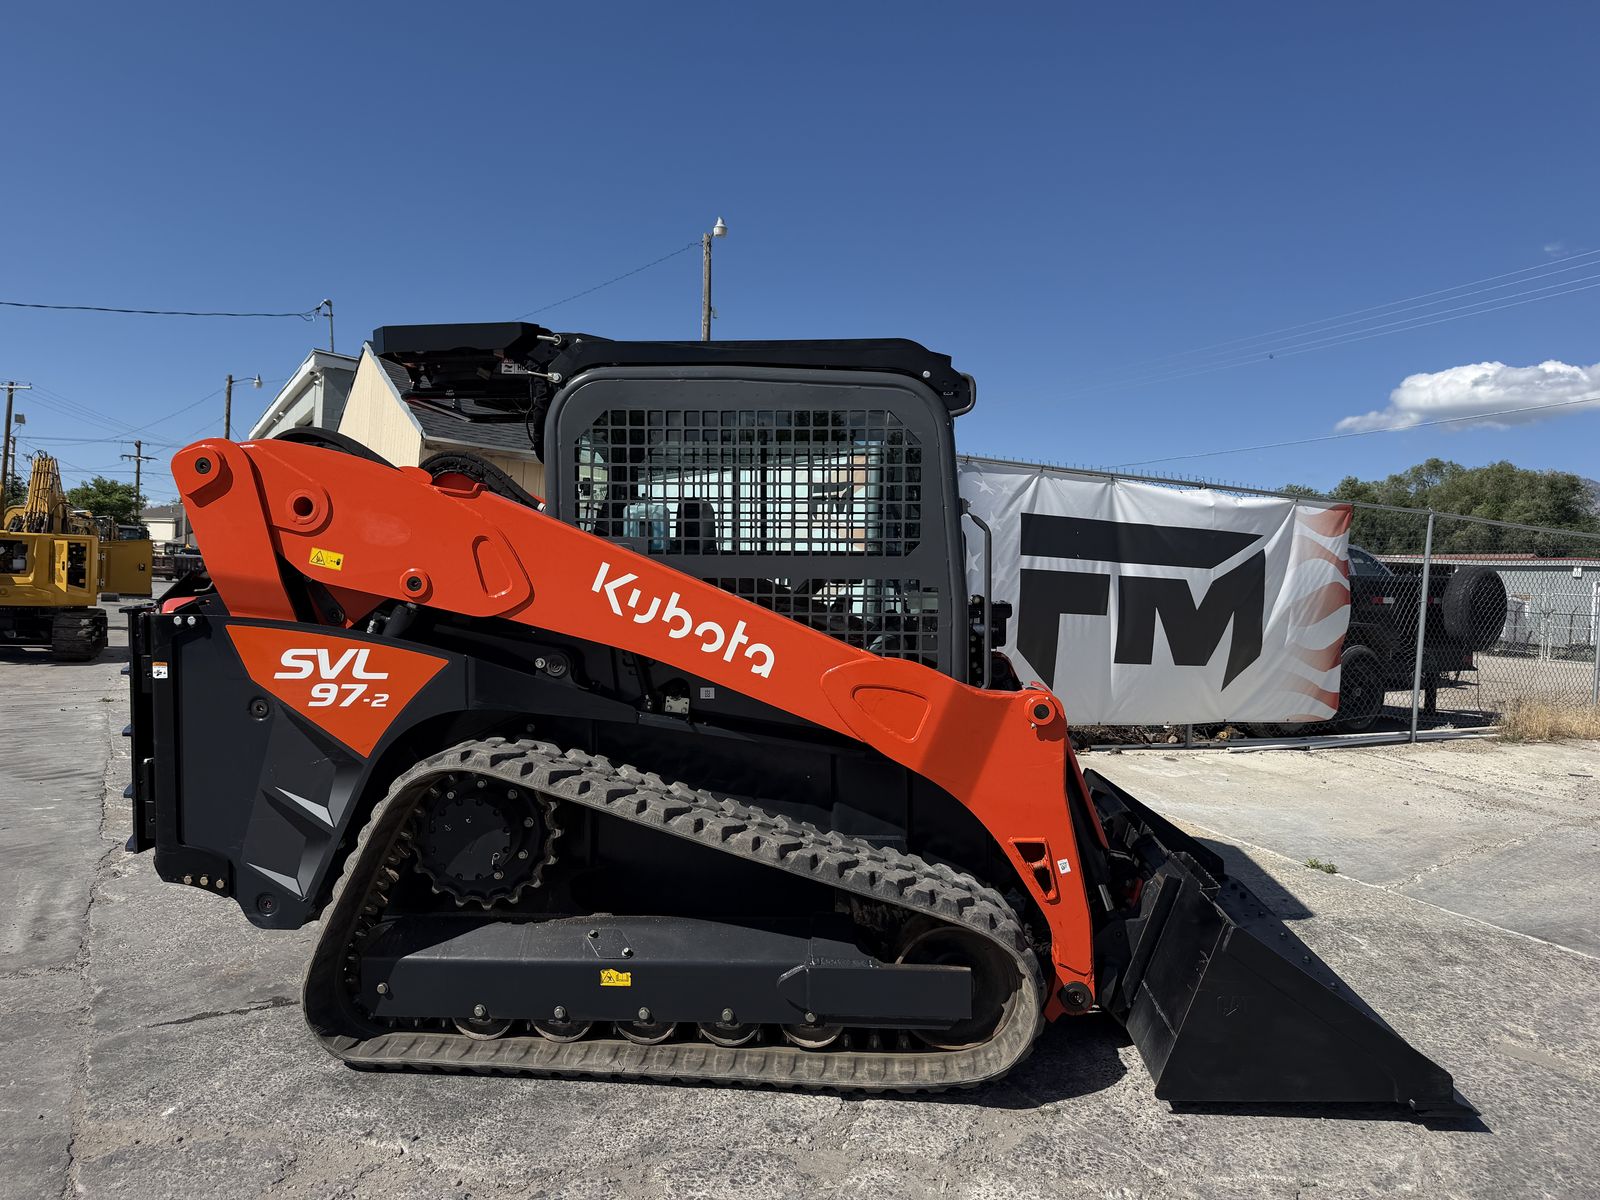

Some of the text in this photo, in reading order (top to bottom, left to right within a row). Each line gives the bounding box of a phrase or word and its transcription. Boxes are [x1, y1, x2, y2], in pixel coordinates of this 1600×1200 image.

[591, 561, 775, 679] Kubota
[273, 648, 389, 680] SVL
[308, 683, 389, 707] 97-2
